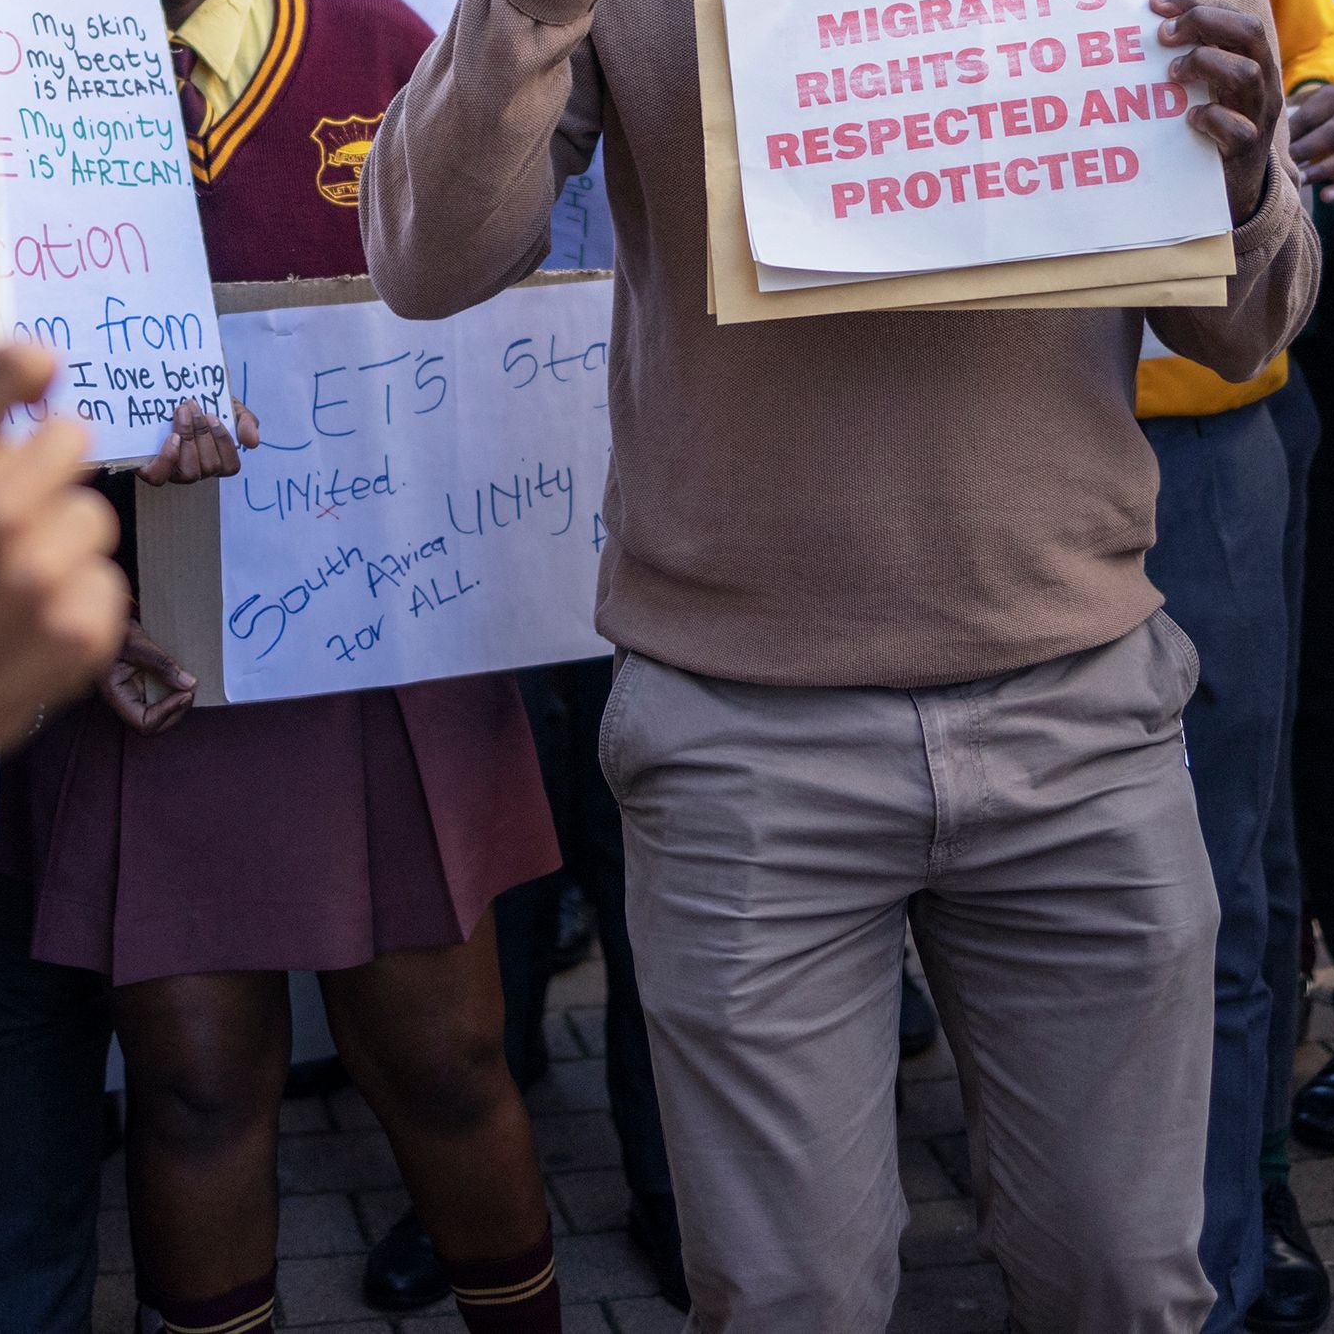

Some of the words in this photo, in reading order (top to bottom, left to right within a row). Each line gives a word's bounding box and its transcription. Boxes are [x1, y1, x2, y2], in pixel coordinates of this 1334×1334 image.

[32, 12, 77, 48] My
[26, 49, 66, 78] my
[78, 48, 163, 80] beaty
[795, 46, 990, 109] RIGHTS
[997, 37, 1067, 79] TO
[1077, 25, 1146, 69] BE
[34, 78, 58, 100] is
[19, 108, 67, 157] My
[72, 109, 173, 156] dignity
[766, 94, 1069, 170] RESPECTED
[1079, 81, 1189, 129] AND
[26, 148, 54, 179] is
[831, 146, 1140, 220] PROTECTED
[95, 296, 203, 355] from
[68, 361, 98, 388] I
[104, 362, 155, 392] love
[161, 361, 225, 397] being
[503, 334, 608, 390] Sta
[77, 398, 115, 426] an
[229, 545, 363, 661] South
[408, 569, 482, 618] ALL.
